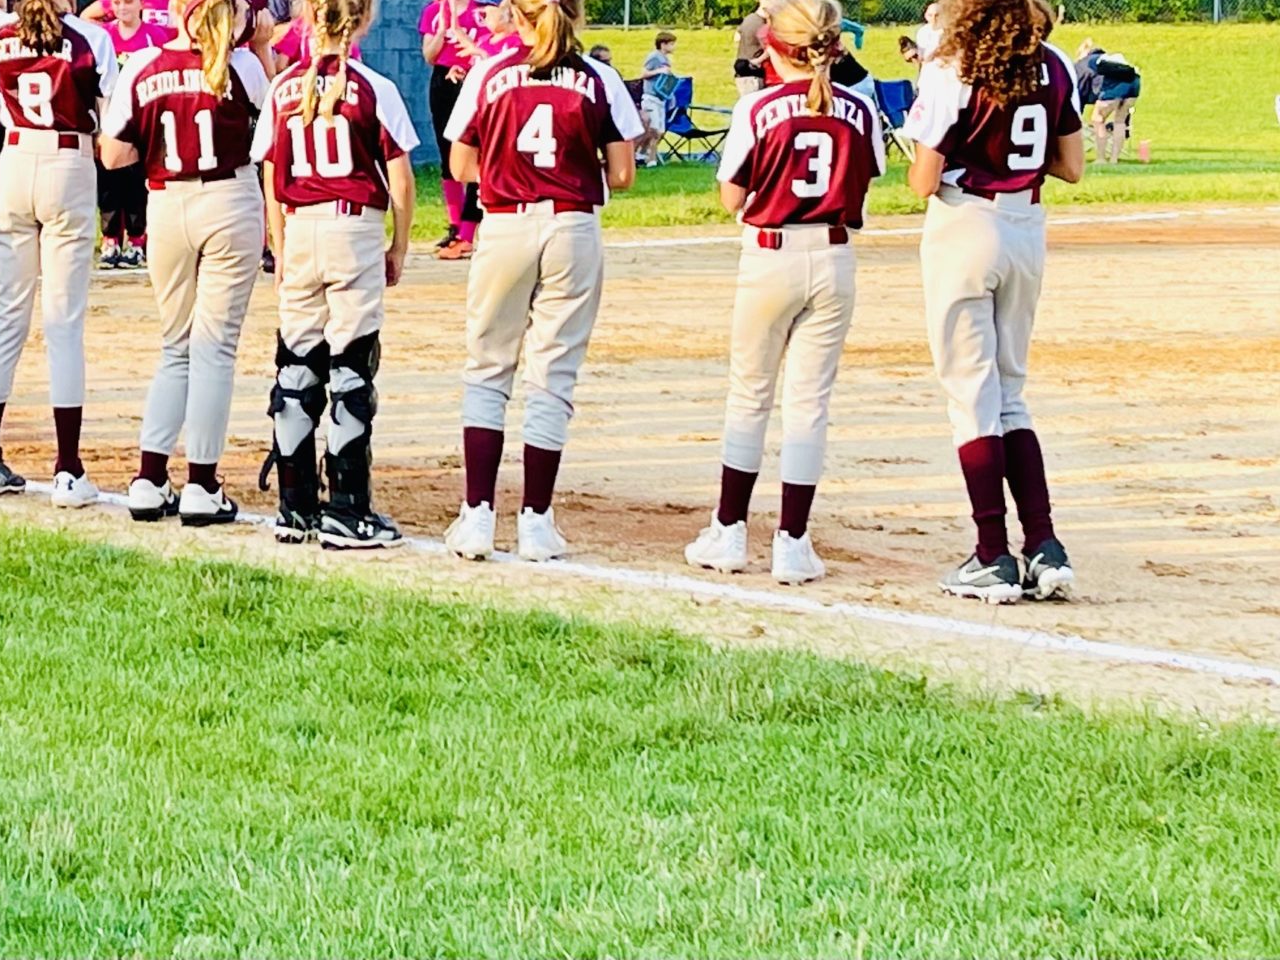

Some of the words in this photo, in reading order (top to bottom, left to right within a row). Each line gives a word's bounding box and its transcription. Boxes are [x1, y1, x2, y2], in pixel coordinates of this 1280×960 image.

[17, 71, 55, 128] 8
[160, 109, 218, 173] 11
[286, 113, 353, 178] 10
[517, 103, 558, 168] 4
[791, 131, 833, 198] 3
[1007, 103, 1048, 171] 9
